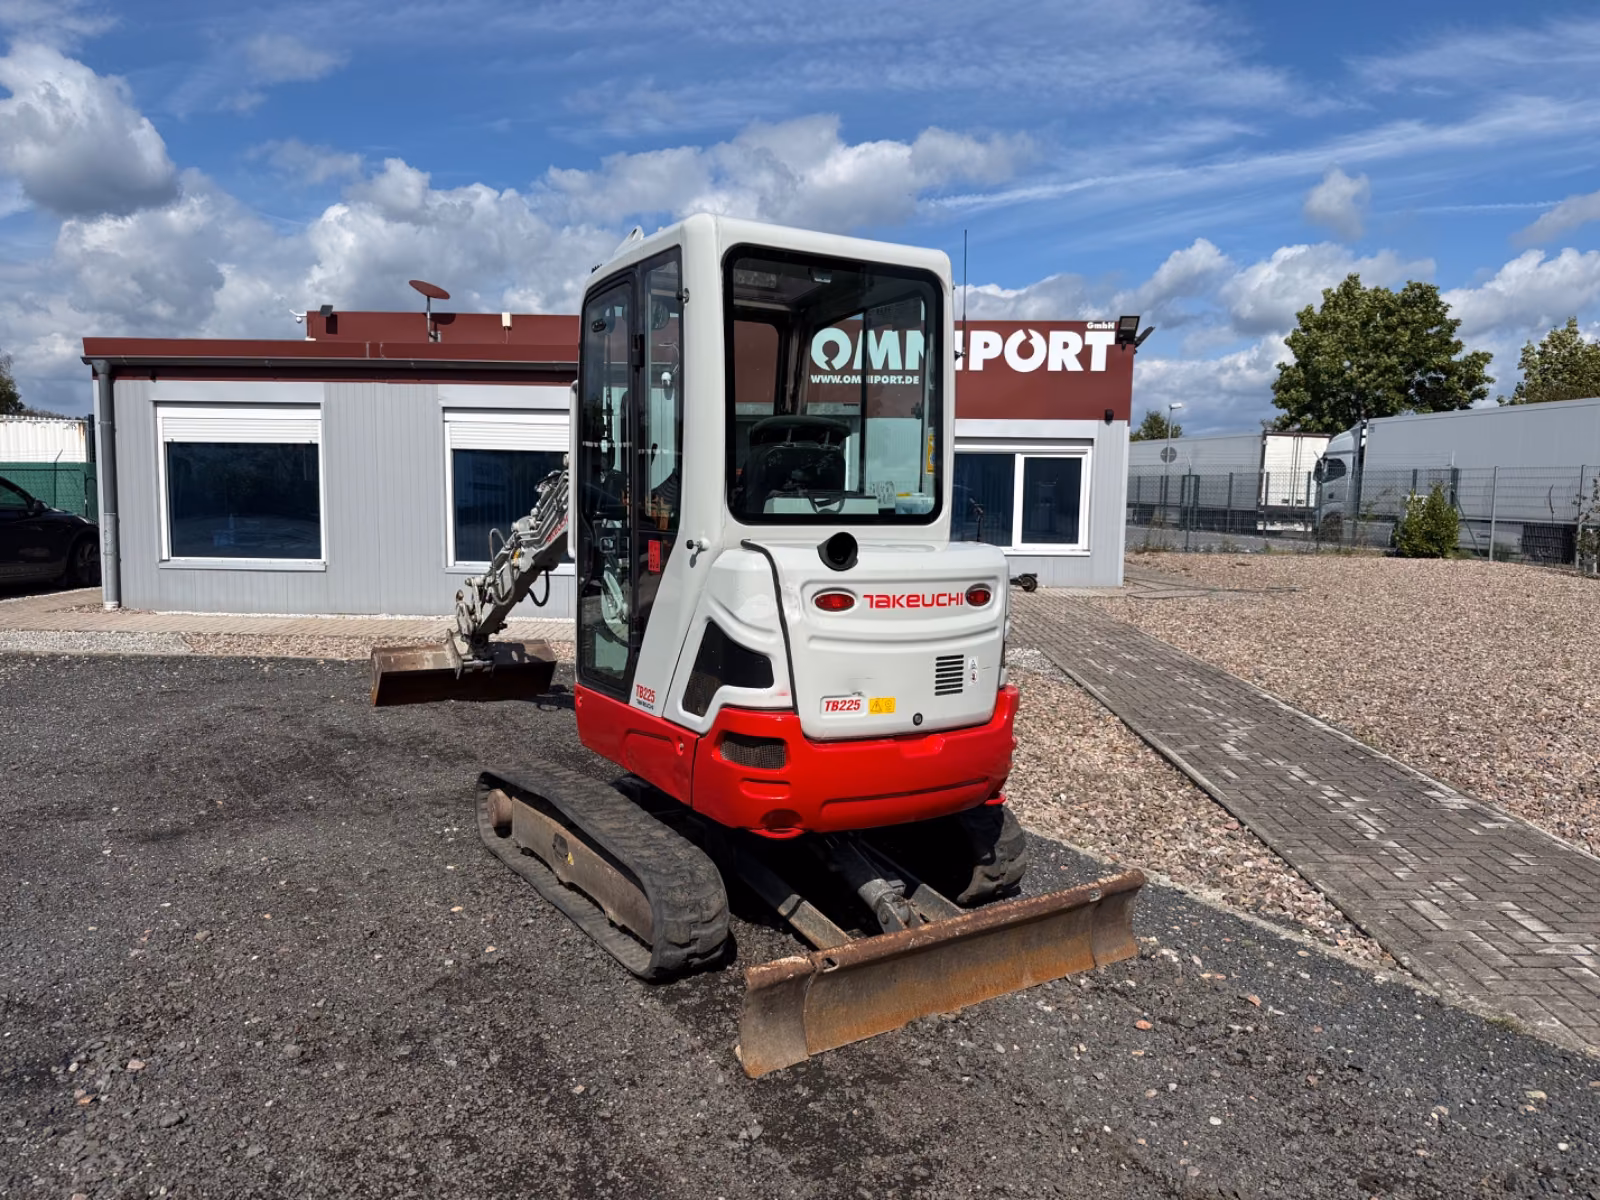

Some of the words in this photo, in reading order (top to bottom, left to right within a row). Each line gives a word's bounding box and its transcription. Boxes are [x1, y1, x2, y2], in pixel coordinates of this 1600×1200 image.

[1087, 321, 1115, 329] GmbH
[863, 592, 964, 609] TAKEUCHI
[636, 684, 656, 703] TB225
[825, 699, 861, 712] TB225
